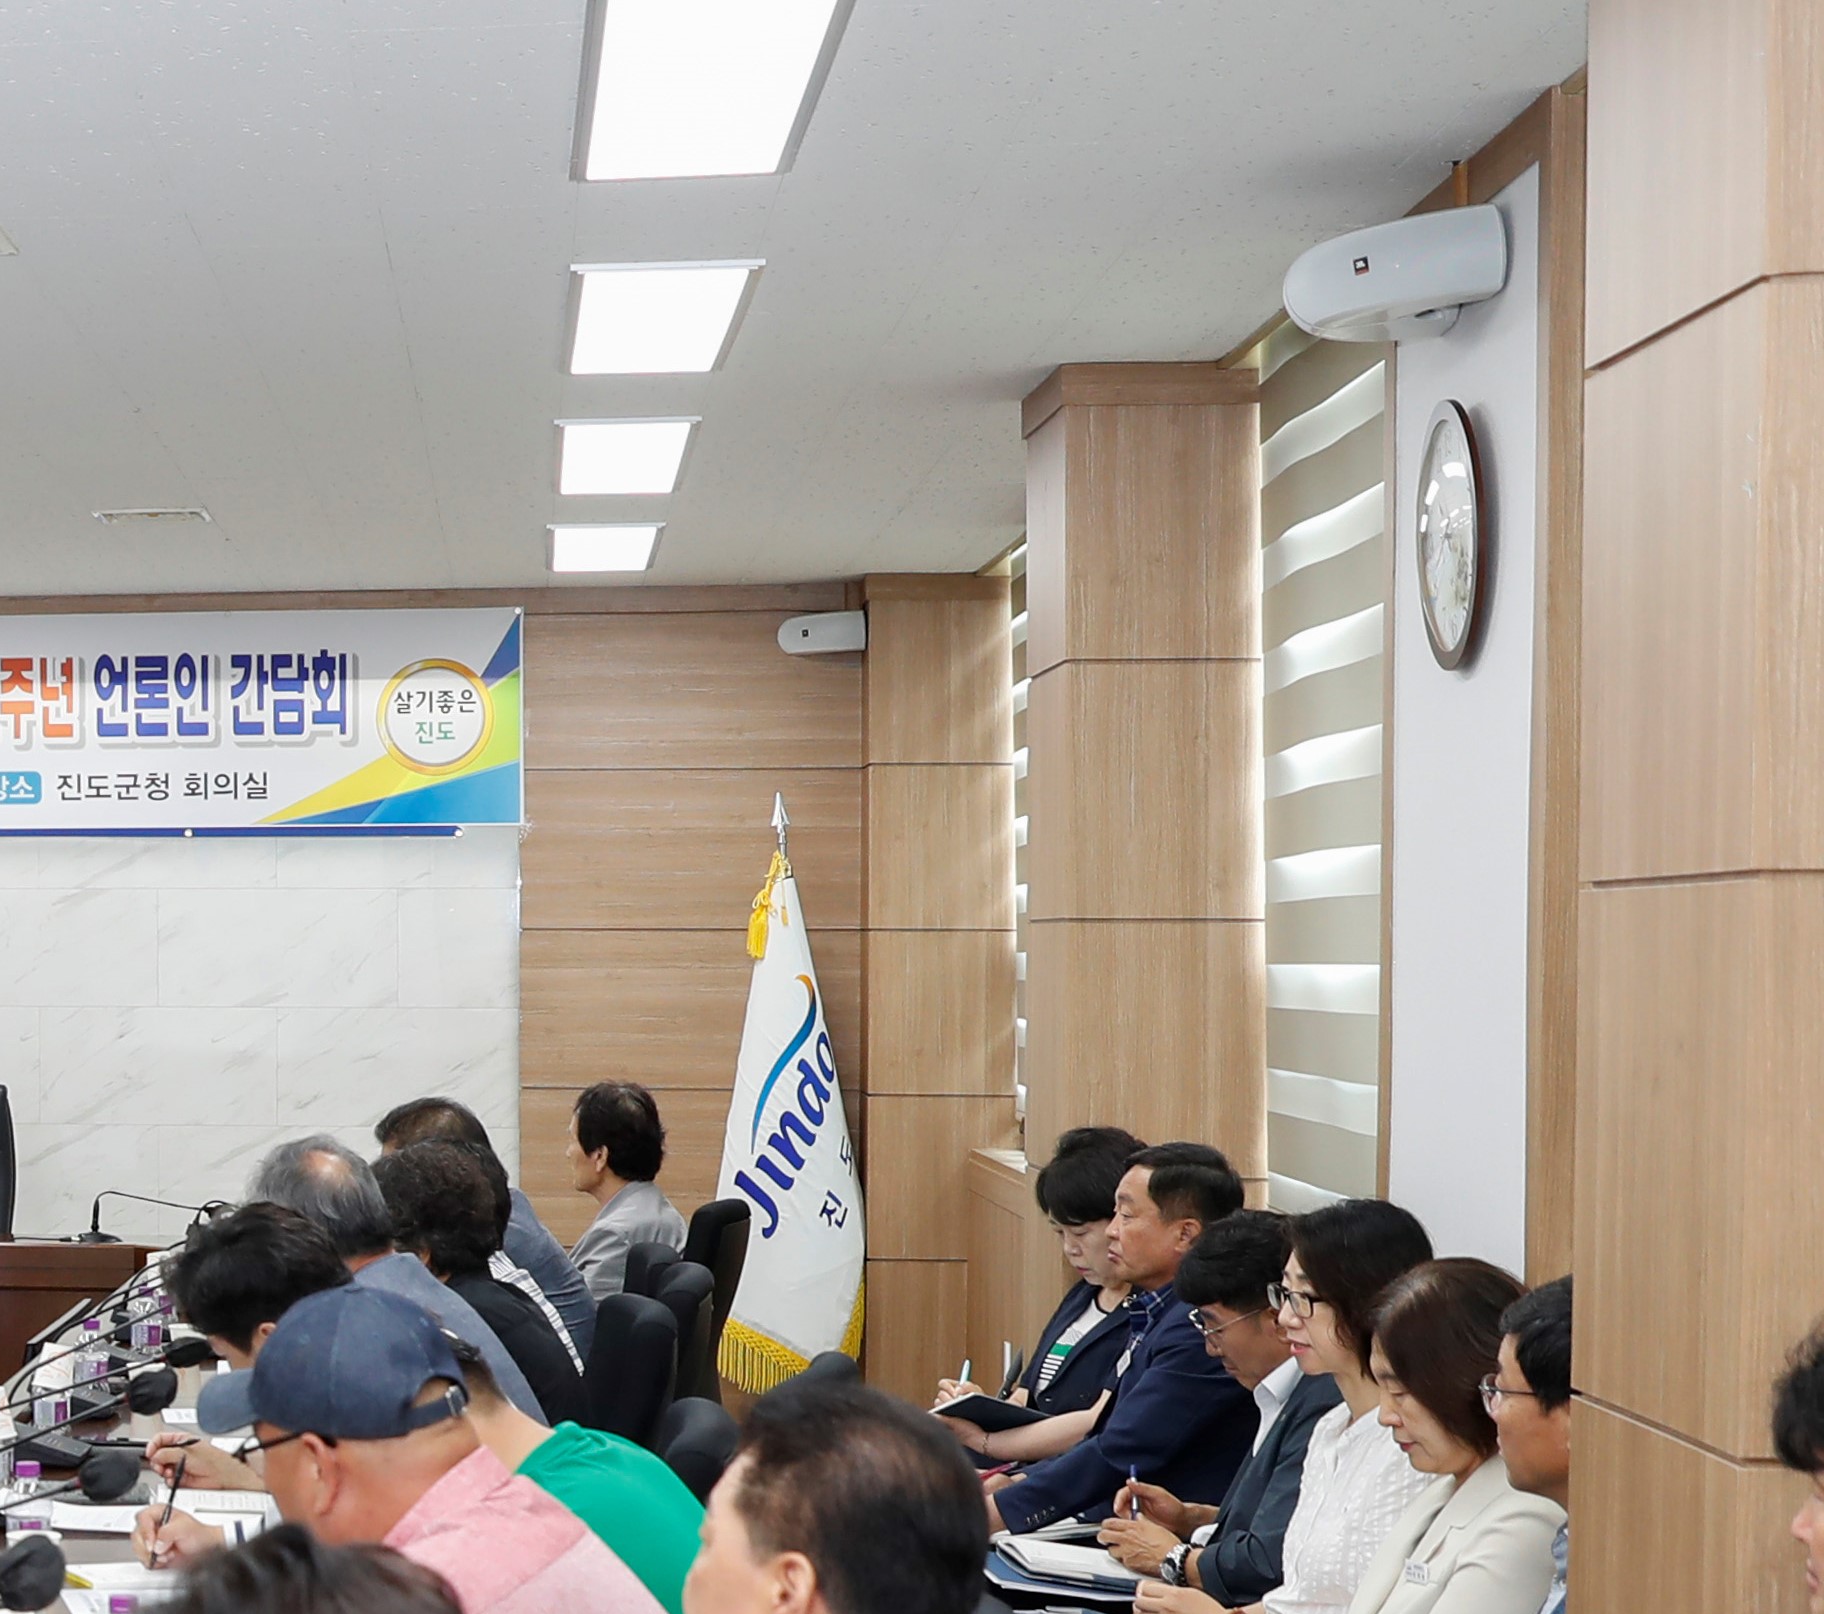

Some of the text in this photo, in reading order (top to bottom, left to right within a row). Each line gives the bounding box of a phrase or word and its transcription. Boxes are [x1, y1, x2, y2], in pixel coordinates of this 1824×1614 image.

[94, 653, 210, 738] 언론인
[230, 649, 347, 736] 간담회
[394, 689, 477, 714] 살기좋은
[415, 722, 455, 744] 진도
[57, 772, 170, 801] 진도군청
[183, 771, 269, 800] 회의실
[734, 1031, 835, 1239] Jindo
